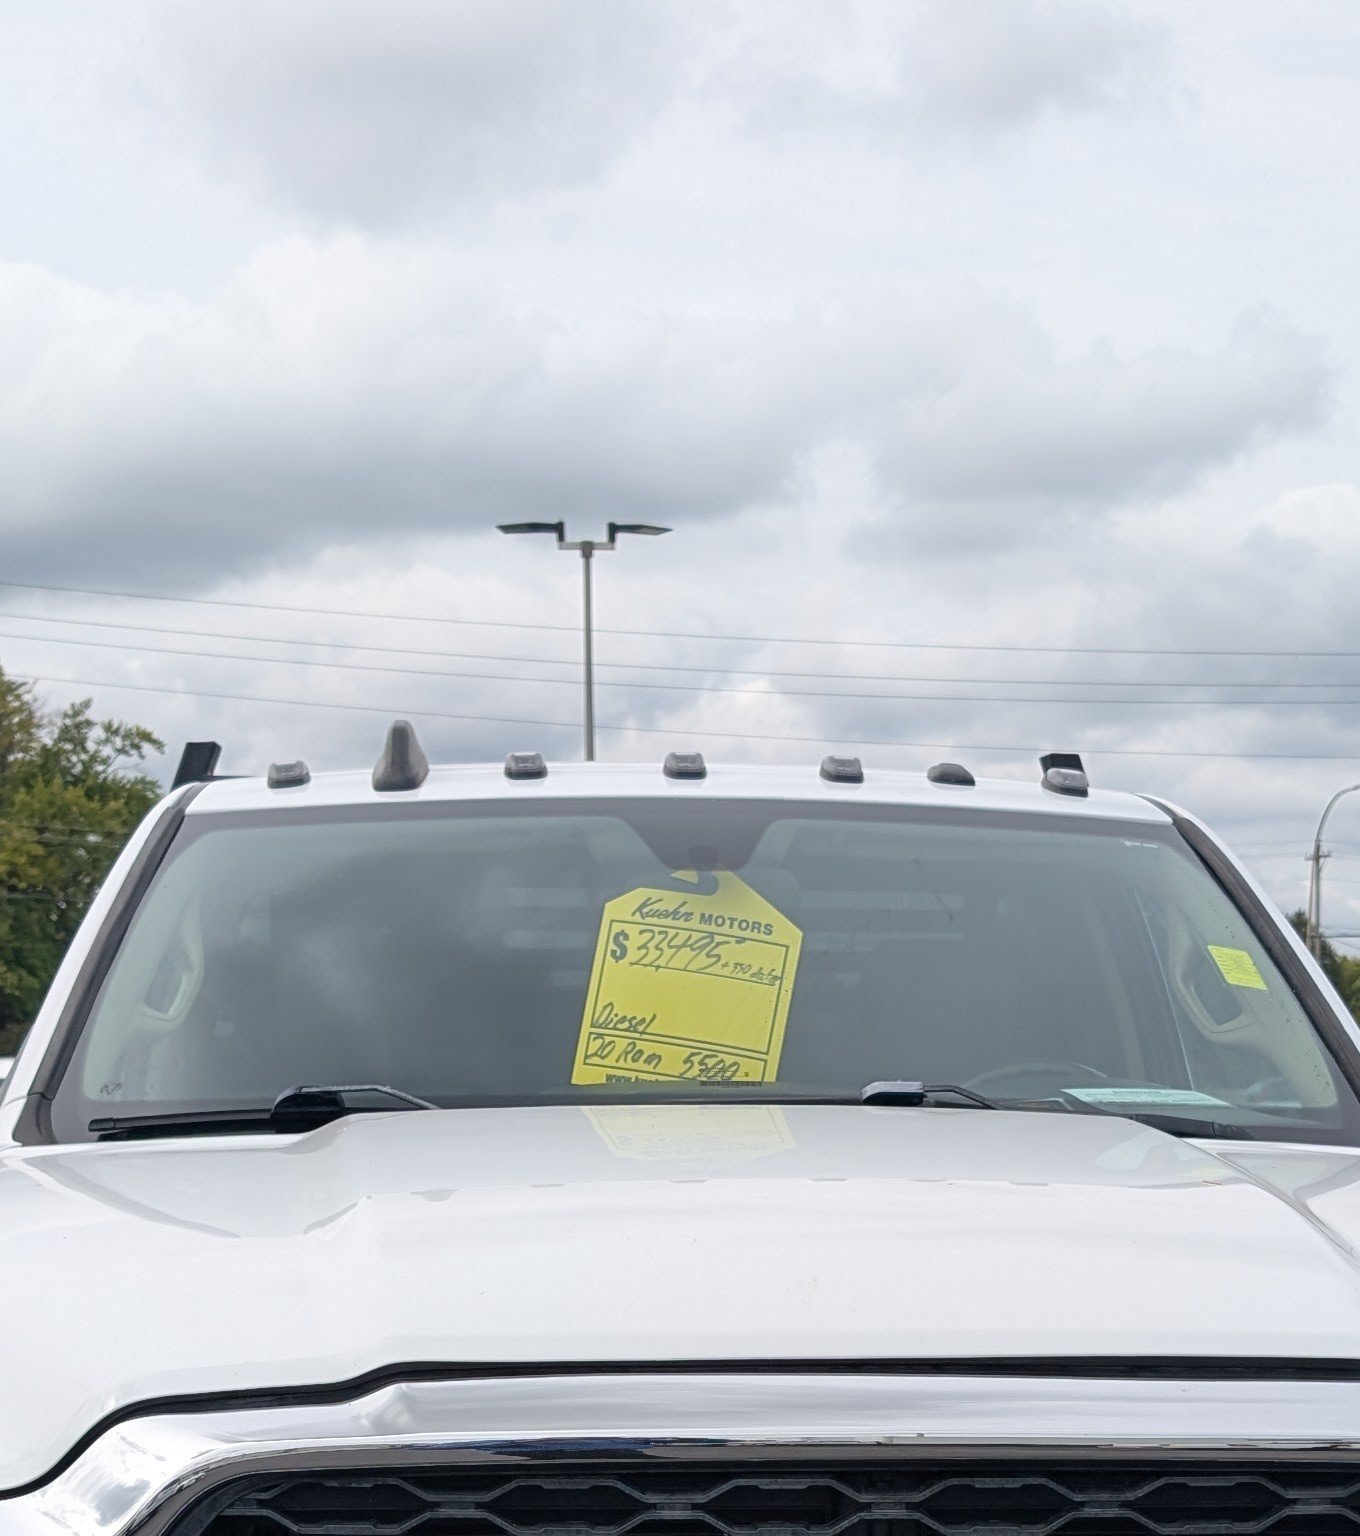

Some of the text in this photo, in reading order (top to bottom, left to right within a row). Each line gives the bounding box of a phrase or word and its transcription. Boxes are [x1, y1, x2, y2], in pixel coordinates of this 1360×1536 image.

[631, 897, 774, 936] Kuehn MOTORS
[591, 1001, 657, 1036] Diesel
[679, 1052, 740, 1081] 5500
